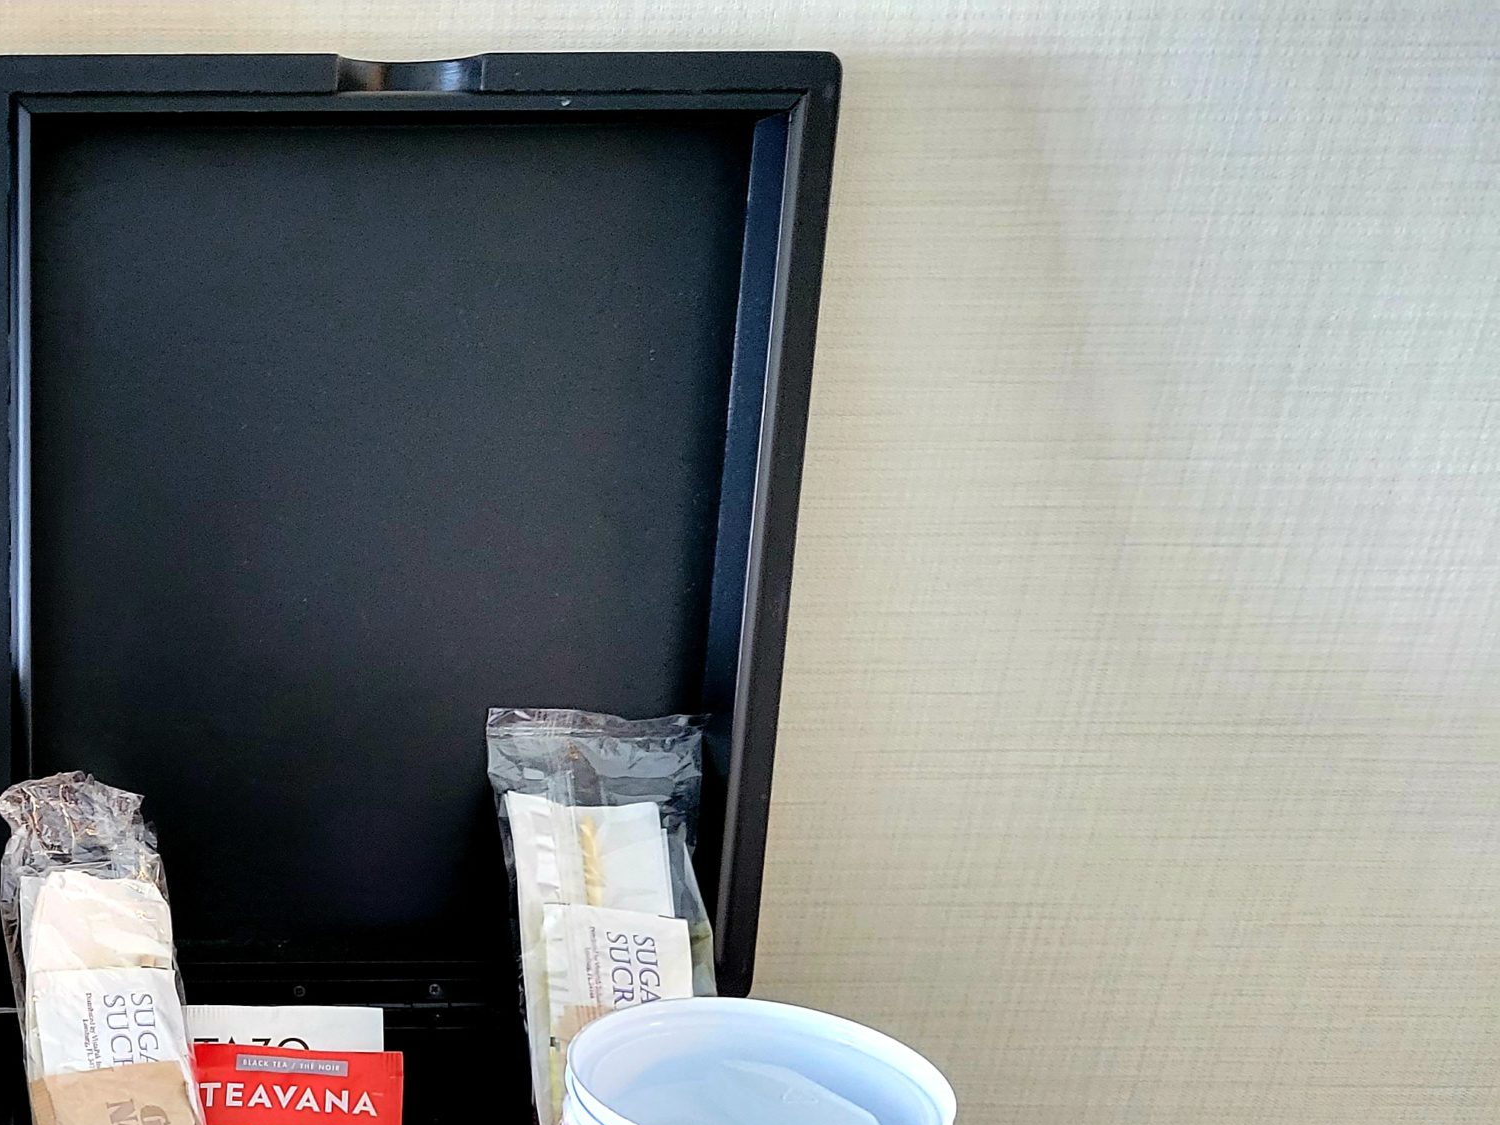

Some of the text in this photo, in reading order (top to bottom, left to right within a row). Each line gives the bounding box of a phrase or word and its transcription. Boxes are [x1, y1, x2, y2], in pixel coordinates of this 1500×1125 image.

[606, 931, 635, 1007] SUCR
[242, 1059, 269, 1067] BLACK
[200, 1082, 378, 1116] TEAVANA
